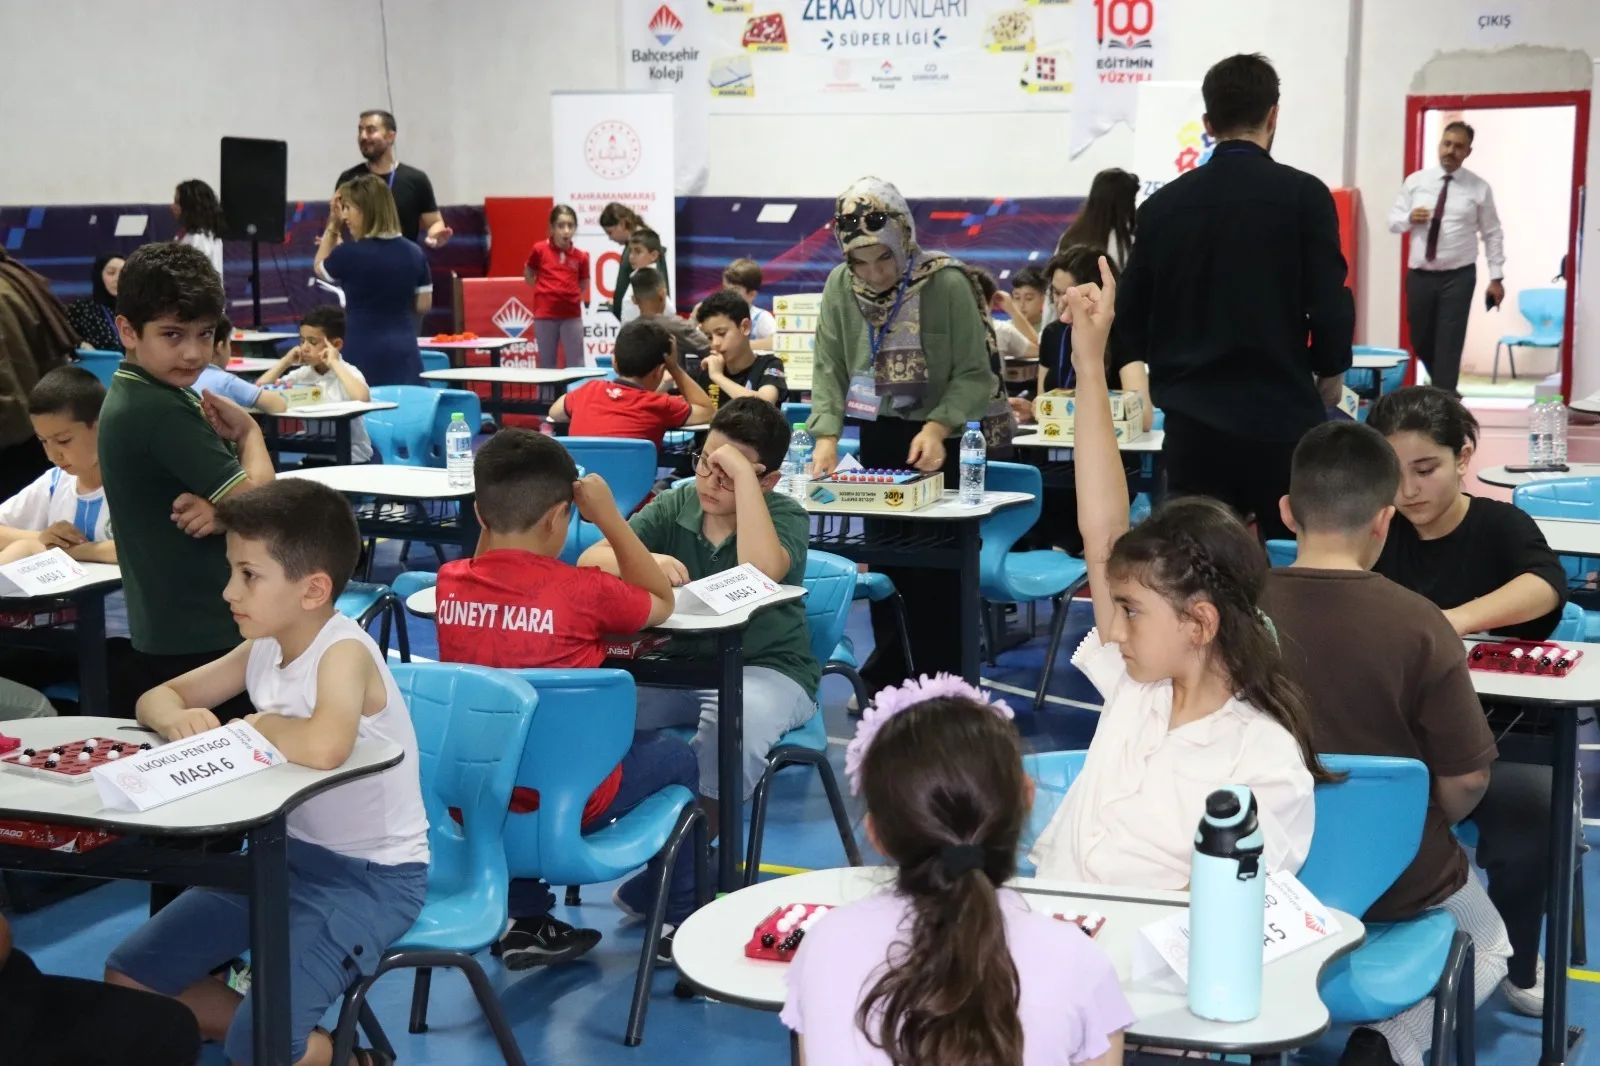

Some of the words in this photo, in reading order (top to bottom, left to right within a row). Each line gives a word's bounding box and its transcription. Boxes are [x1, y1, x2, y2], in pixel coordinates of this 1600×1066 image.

[1093, 0, 1154, 43] 100
[1478, 14, 1511, 29] ÇIKIŞ
[839, 32, 891, 46] SÜPER
[896, 29, 929, 46] LİGİ
[631, 47, 699, 62] Bahçeşehir
[1096, 56, 1153, 70] EĞİTİMİN
[648, 66, 684, 83] Koleji
[569, 191, 656, 202] KAHRAMANMARAŞ
[583, 325, 618, 338] EĞİT
[725, 588, 750, 603] MASA
[748, 585, 757, 594] 3
[438, 592, 499, 629] CÜNEYT
[501, 605, 554, 635] KARA
[135, 752, 182, 773] İLKOKUL
[182, 737, 232, 759] PENTAGO
[169, 762, 223, 787] MASA
[220, 757, 235, 770] 6
[0, 829, 23, 837] TAGO
[1267, 922, 1287, 940] 5
